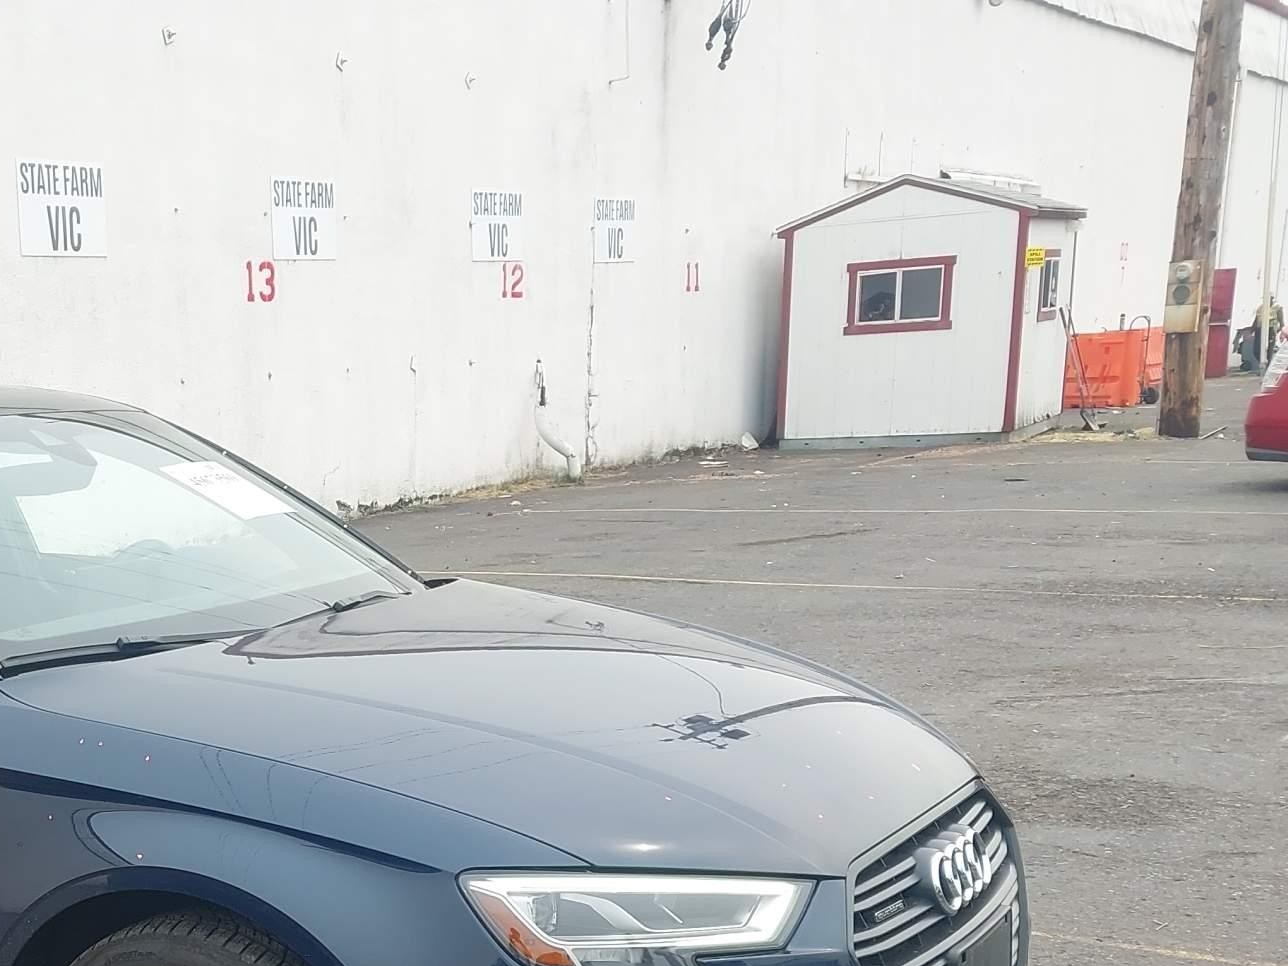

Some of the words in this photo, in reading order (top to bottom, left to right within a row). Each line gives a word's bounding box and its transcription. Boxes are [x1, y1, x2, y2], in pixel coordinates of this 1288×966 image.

[20, 163, 60, 196] STATE
[63, 166, 103, 198] FARM
[274, 180, 303, 207] STATE
[305, 182, 334, 209] FARM
[473, 192, 498, 216] STATE
[499, 193, 522, 217] FARM
[596, 199, 614, 221] STATE
[616, 200, 635, 221] FARM
[47, 205, 82, 252] VIC
[293, 216, 318, 256] VIC
[489, 223, 508, 257] VIC
[608, 227, 624, 259] VIC
[245, 261, 276, 302] 13
[501, 263, 524, 298] 12
